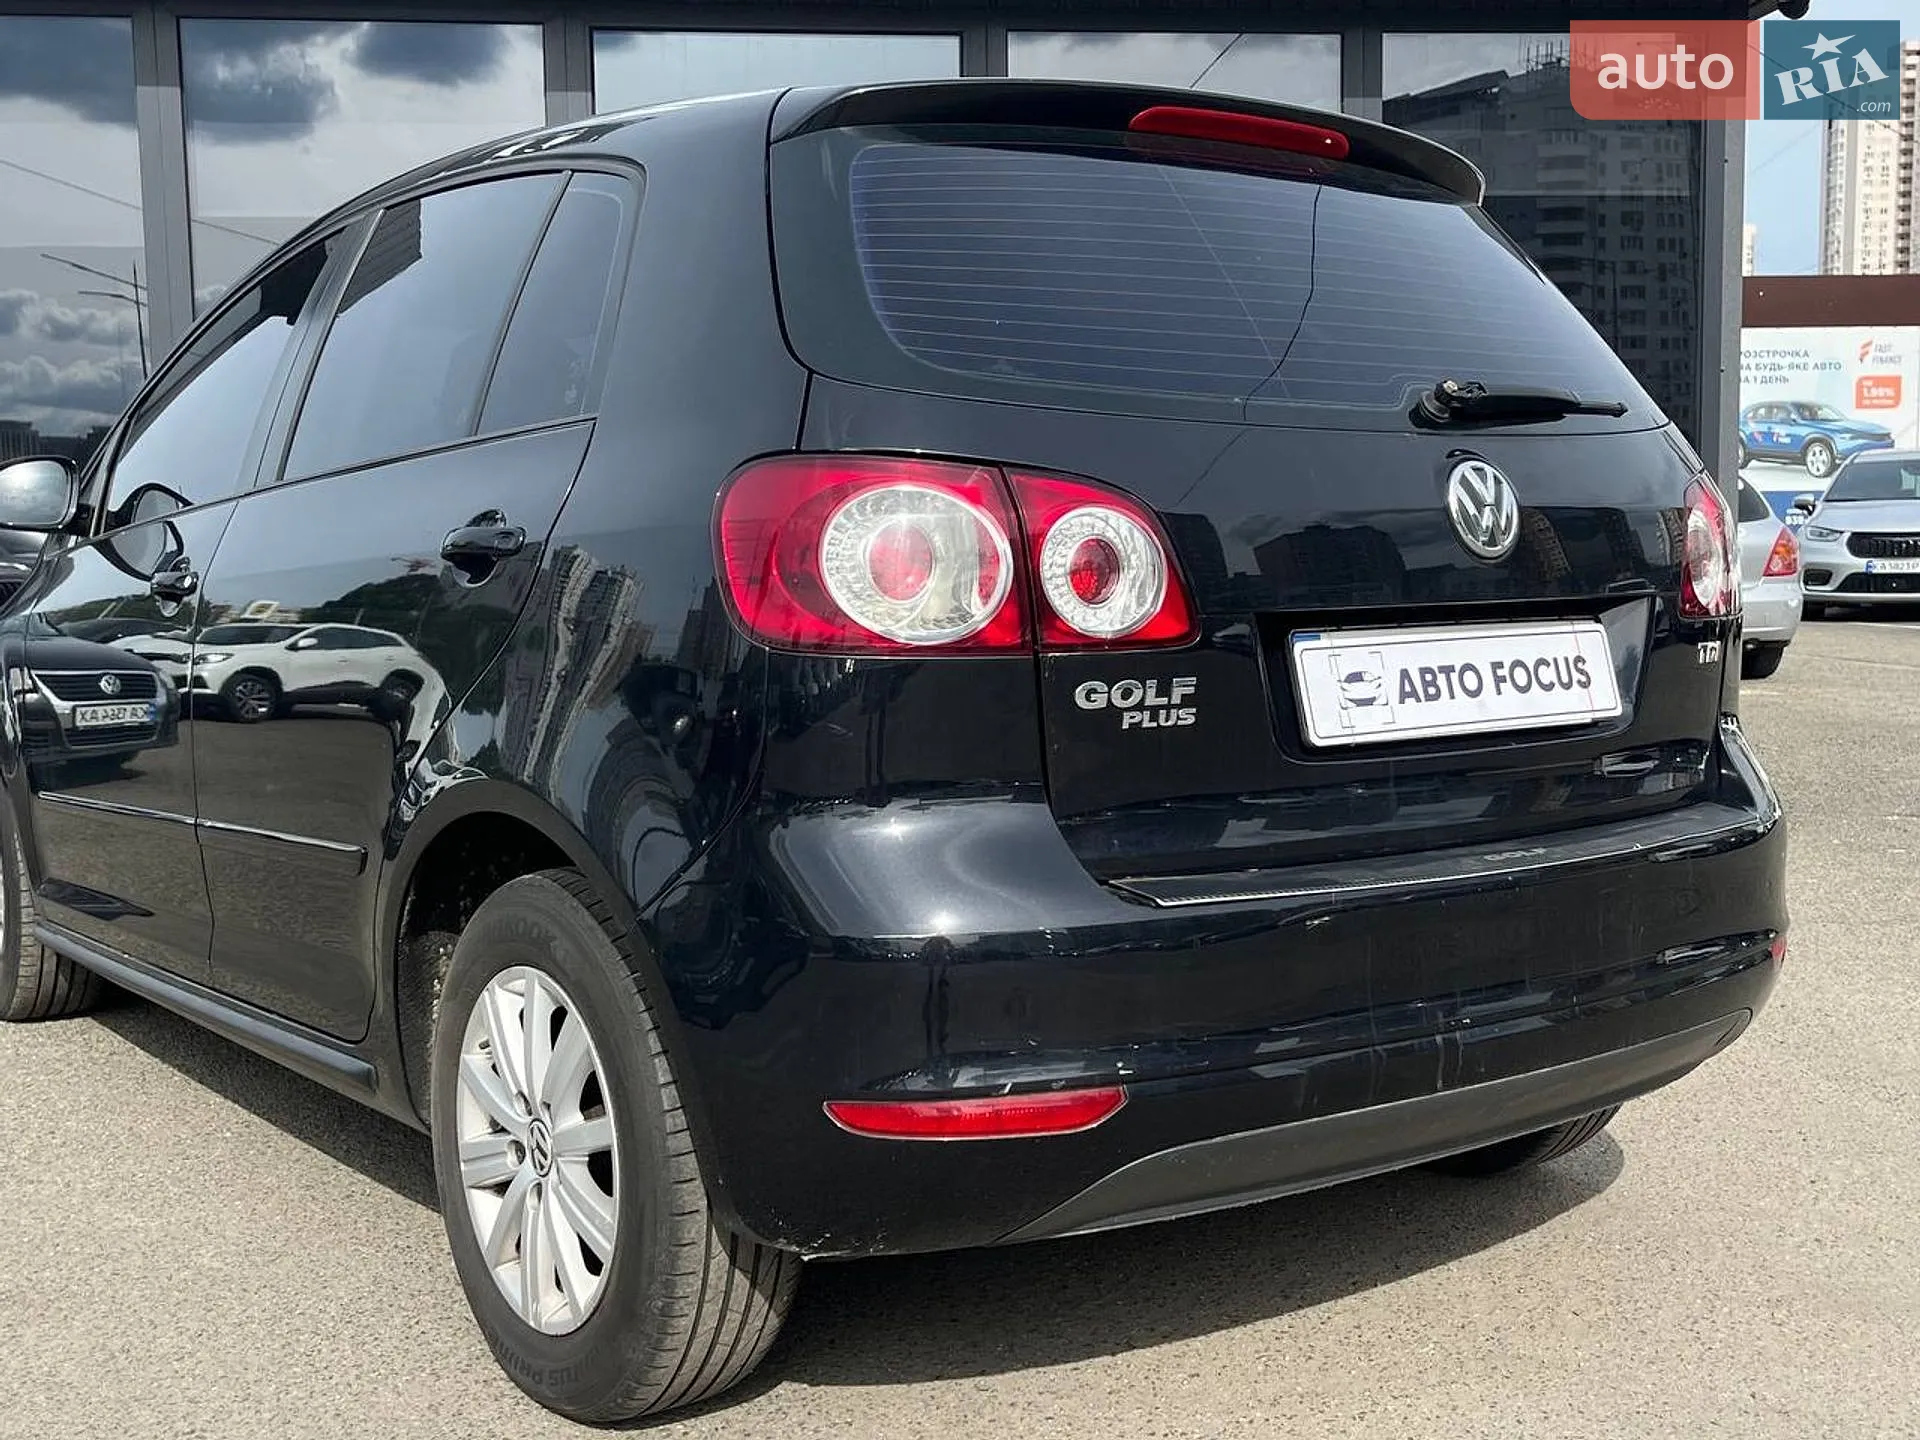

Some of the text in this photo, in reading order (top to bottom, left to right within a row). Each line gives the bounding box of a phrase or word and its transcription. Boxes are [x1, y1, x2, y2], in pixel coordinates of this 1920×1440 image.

[1489, 655, 1592, 697] FOCUS
[1075, 677, 1197, 710] GOLF
[1122, 707, 1197, 729] PLUS
